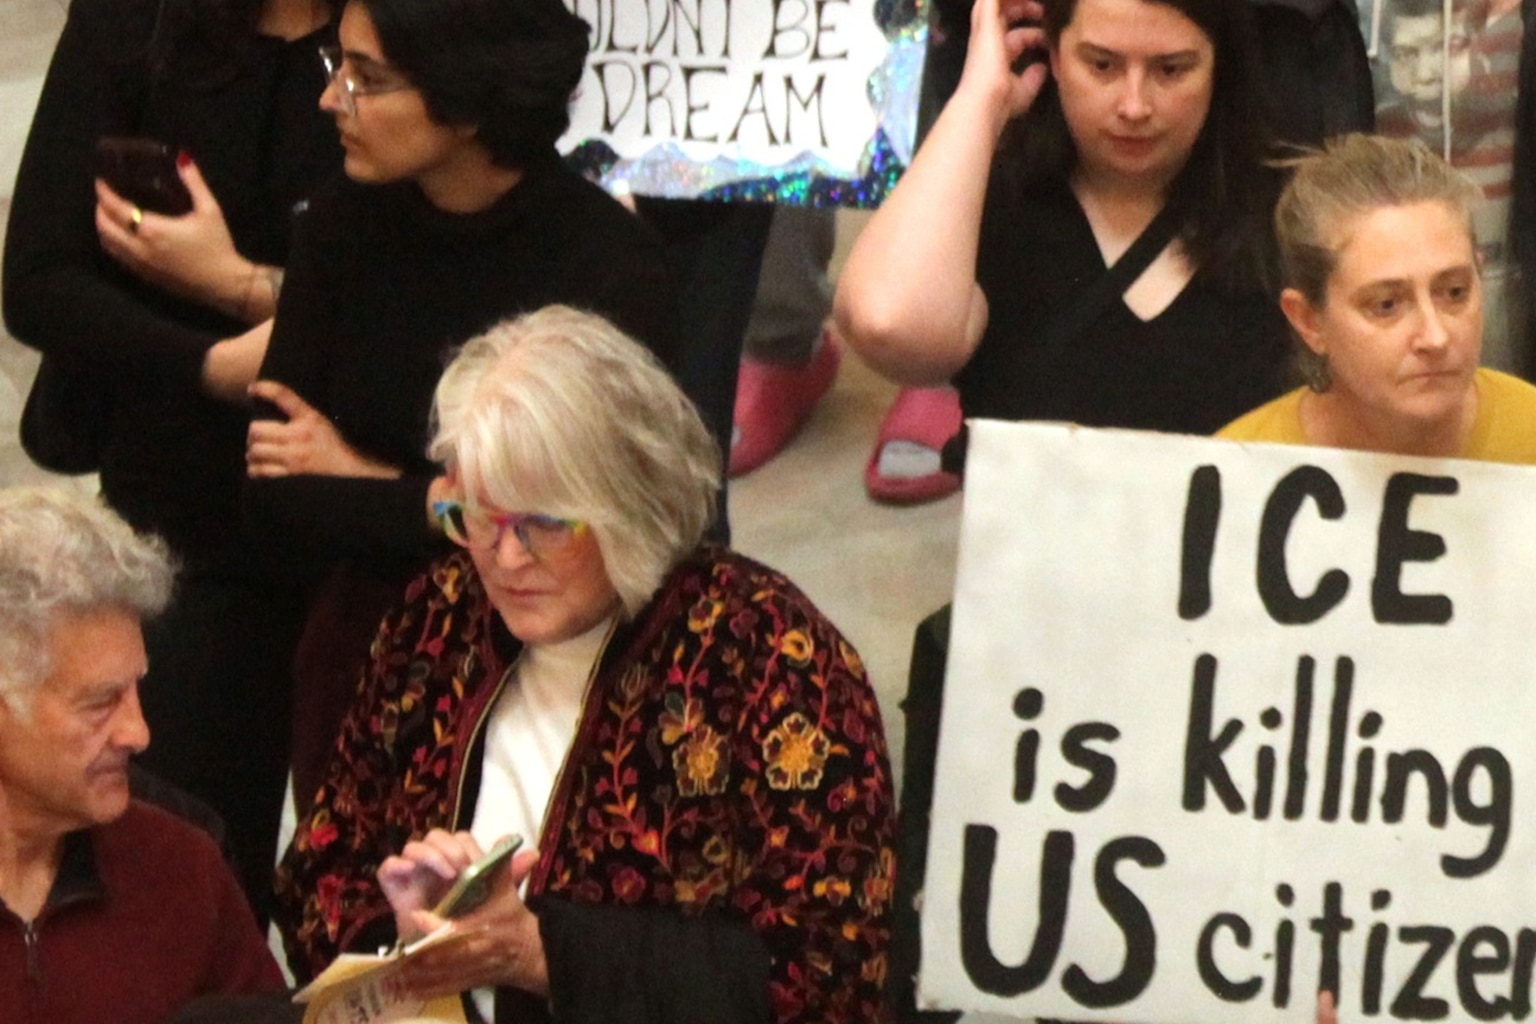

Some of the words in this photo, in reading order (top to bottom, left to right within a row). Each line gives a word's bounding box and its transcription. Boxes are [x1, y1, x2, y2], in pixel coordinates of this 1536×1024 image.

[591, 61, 830, 148] DREAM
[1177, 463, 1460, 626] ICE
[1011, 686, 1122, 813] is
[1181, 652, 1514, 878] killing
[959, 823, 1167, 1009] US
